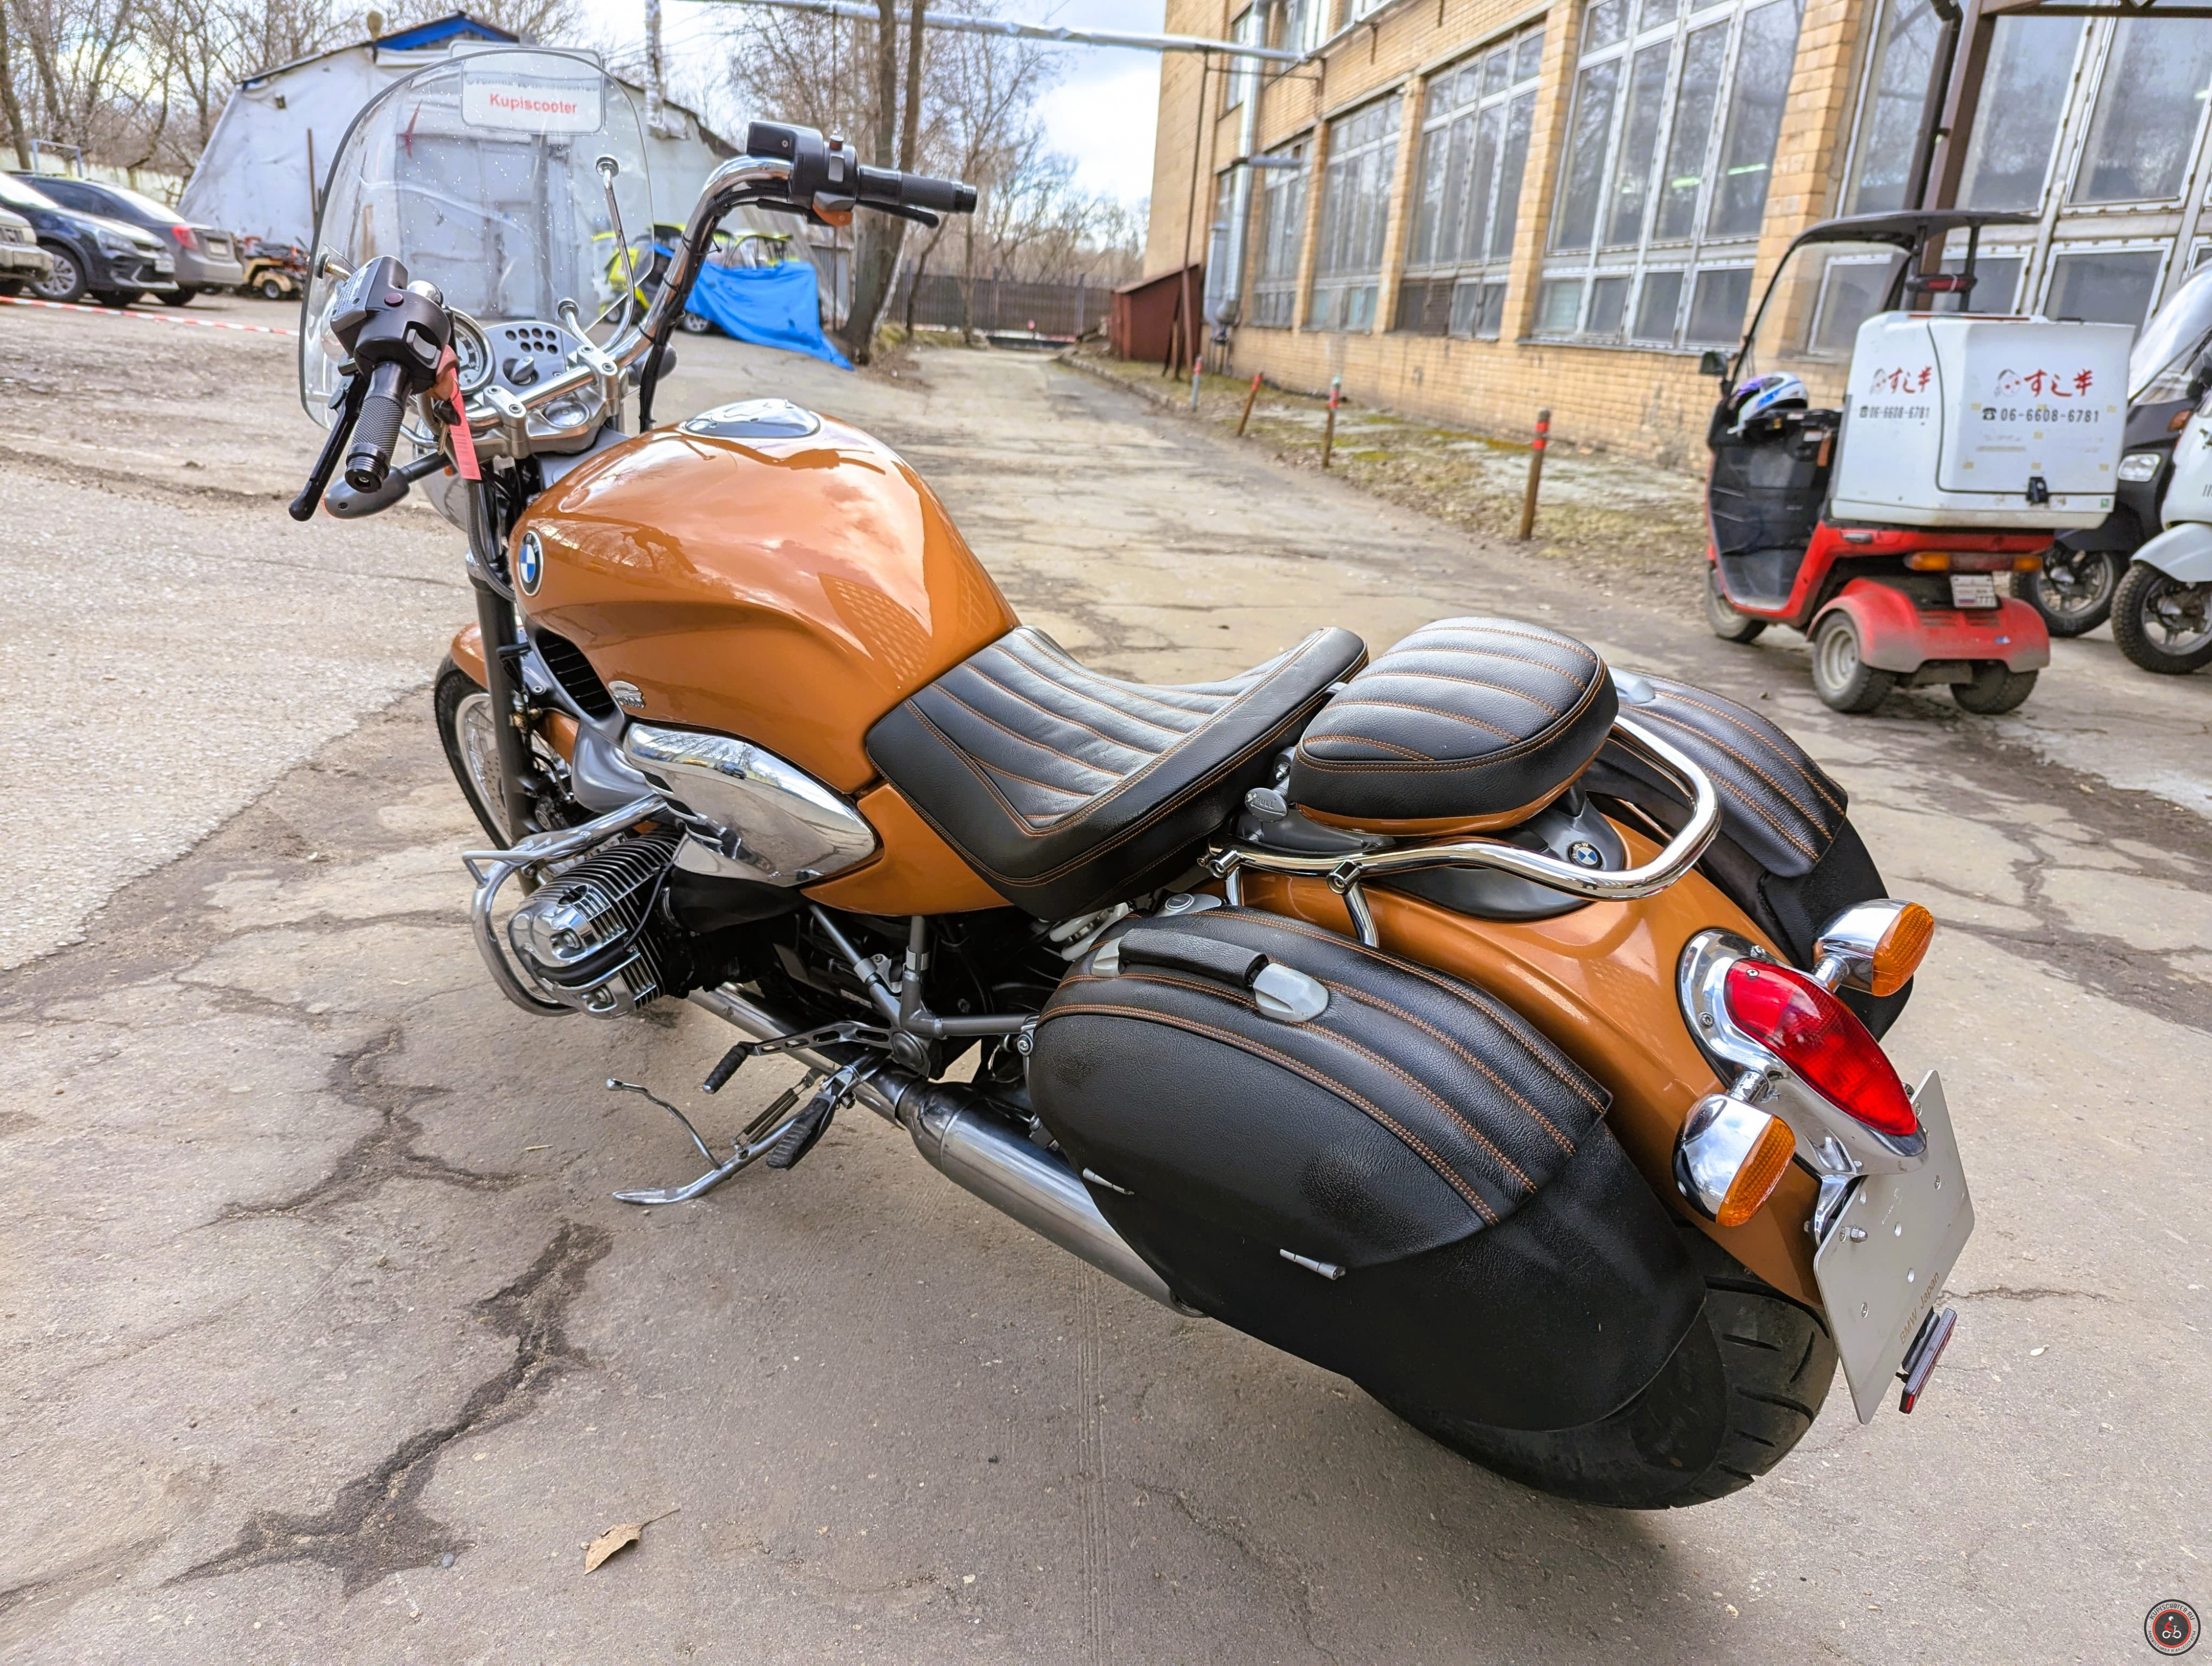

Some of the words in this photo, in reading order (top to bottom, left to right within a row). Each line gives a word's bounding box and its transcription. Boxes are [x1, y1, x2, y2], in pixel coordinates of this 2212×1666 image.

[490, 93, 577, 114] Kupiscooter
[2000, 408, 2099, 423] 06-6608-6781
[1255, 797, 1275, 810] PULL
[1899, 1307, 1918, 1345] BMW
[1920, 1272, 1939, 1309] Japan
